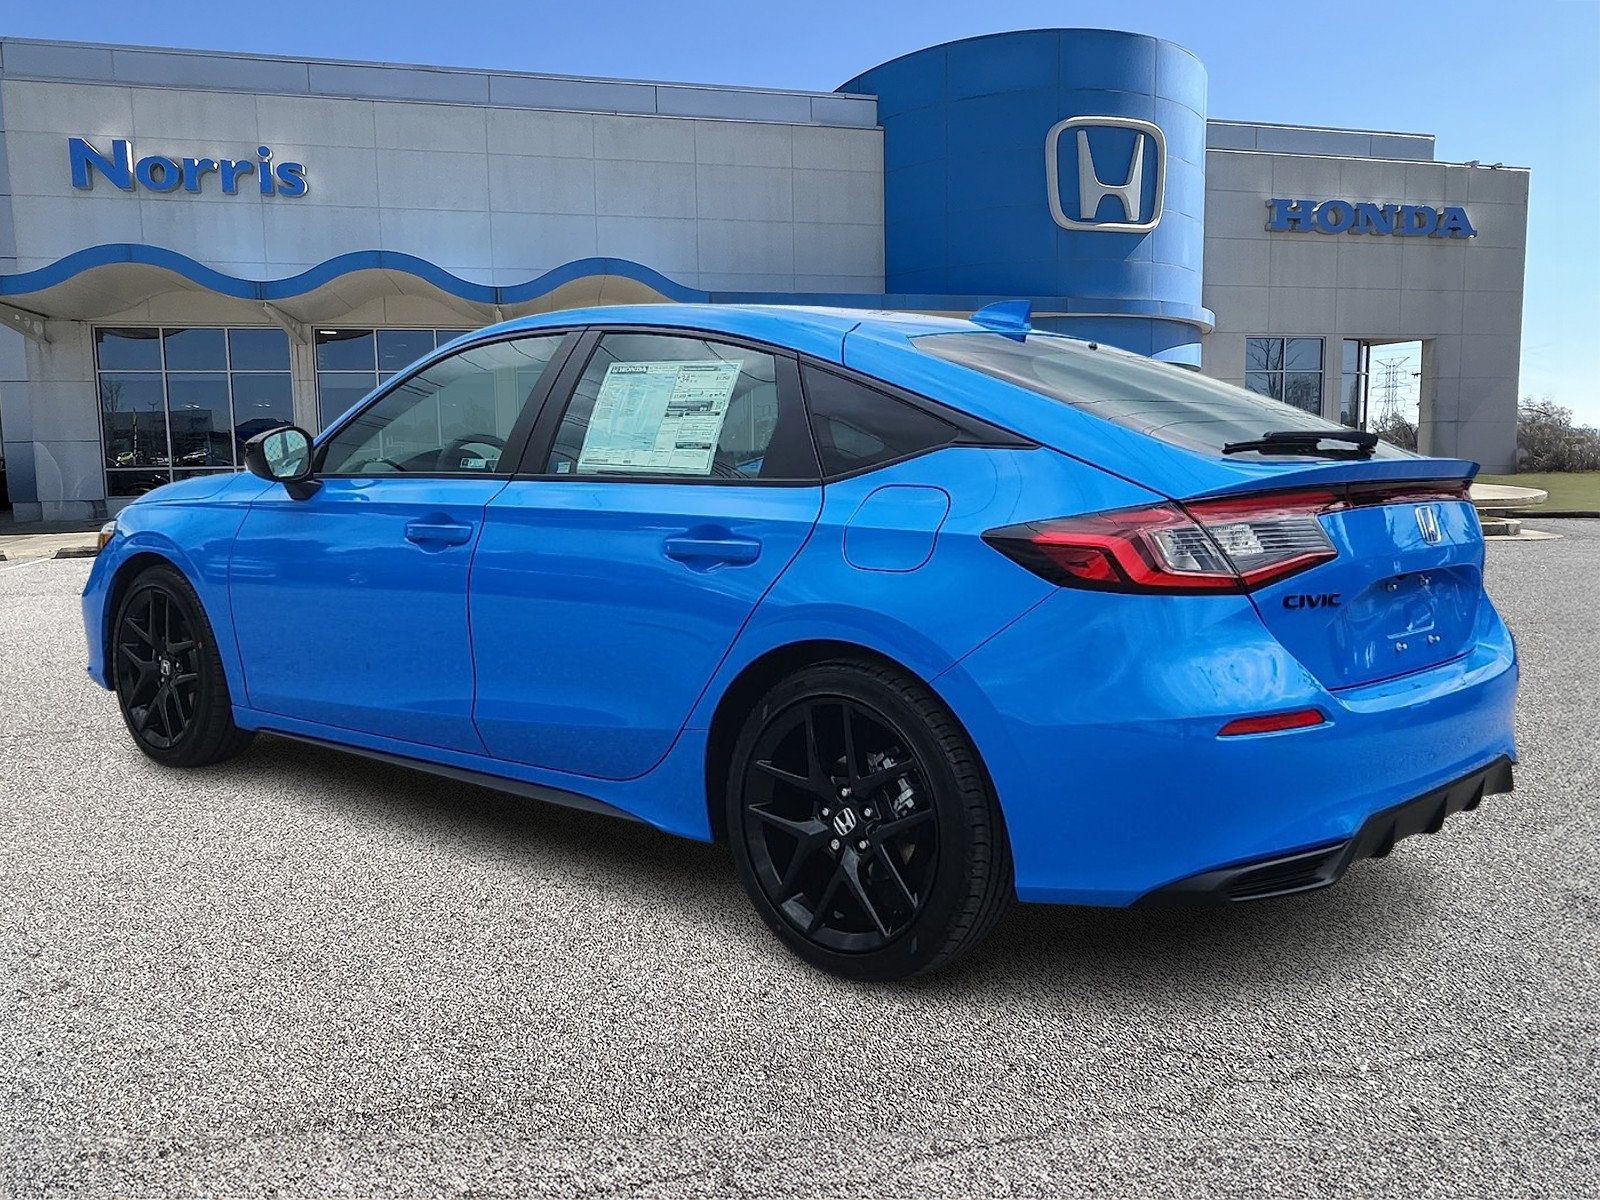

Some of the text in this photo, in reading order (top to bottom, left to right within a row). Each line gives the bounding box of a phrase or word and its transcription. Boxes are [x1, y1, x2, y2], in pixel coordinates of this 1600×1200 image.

[68, 137, 309, 198] Norris
[1265, 198, 1478, 239] HONDA
[1282, 594, 1342, 609] CIVIC
